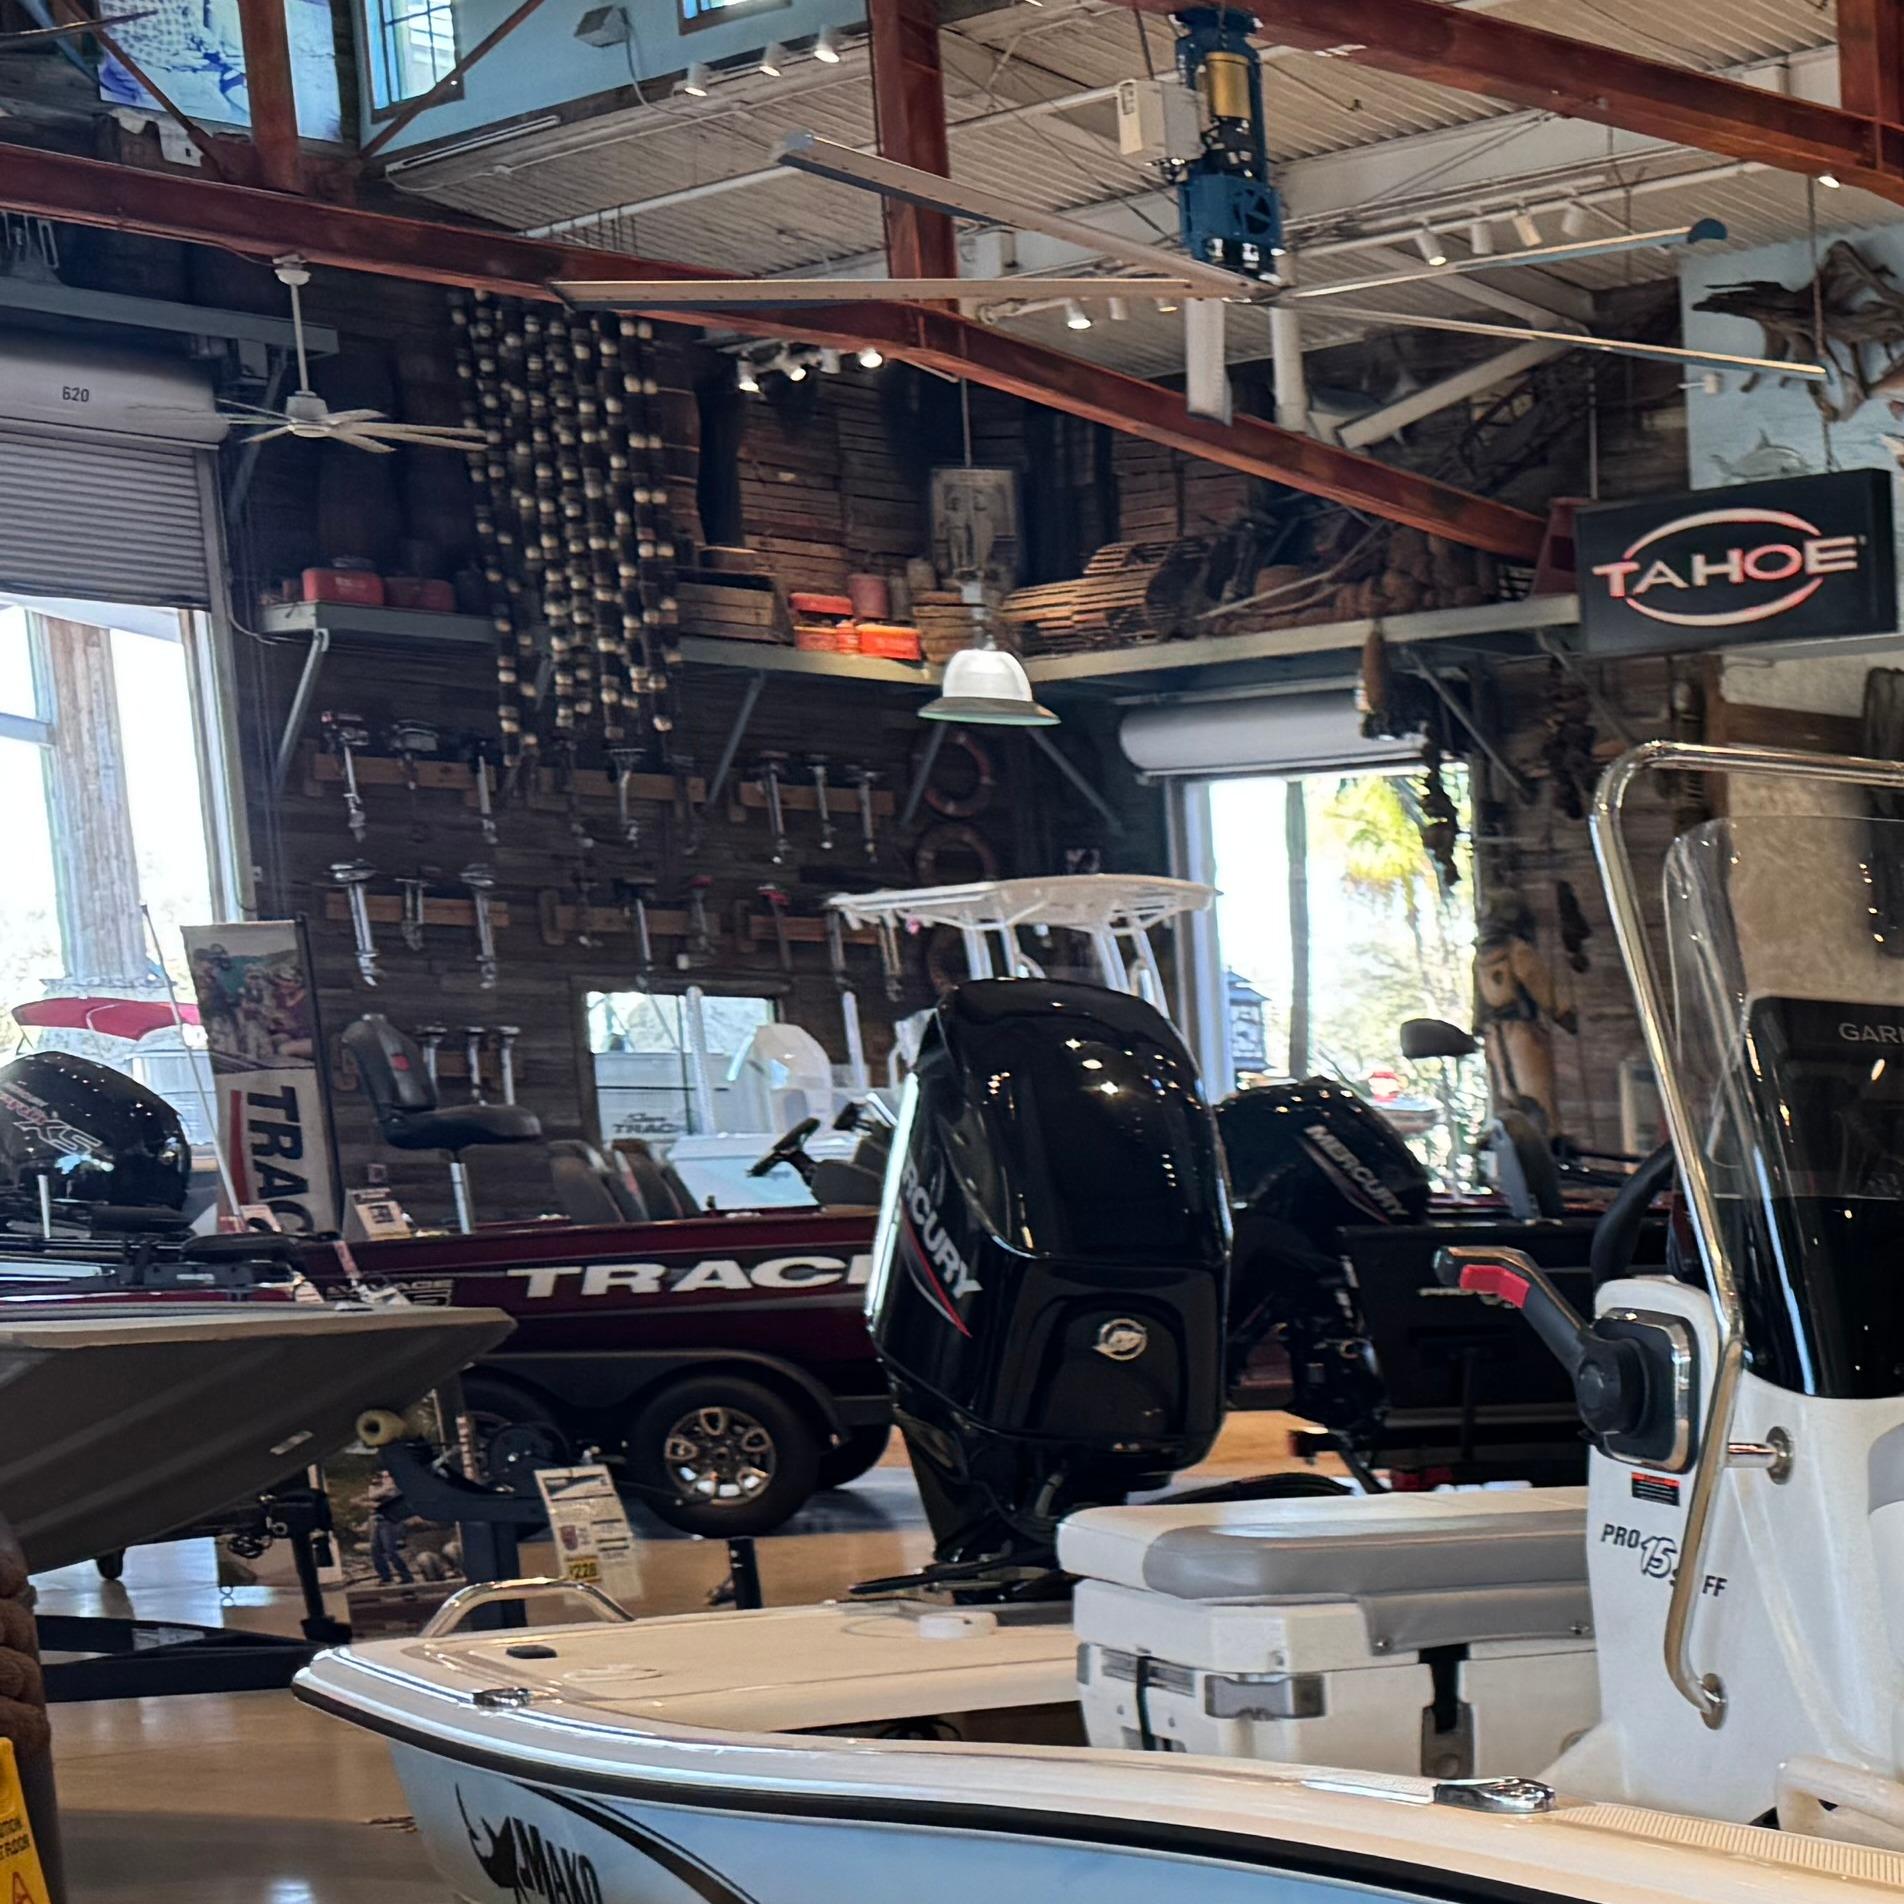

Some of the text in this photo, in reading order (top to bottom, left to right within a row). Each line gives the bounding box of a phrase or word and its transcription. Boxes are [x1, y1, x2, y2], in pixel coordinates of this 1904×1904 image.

[62, 386, 90, 402] 620
[1592, 534, 1860, 599] TAHOE
[247, 1085, 315, 1234] TRAC
[902, 1148, 984, 1299] RCURY
[1600, 1523, 1641, 1549] PRO
[1641, 1535, 1678, 1579] 15
